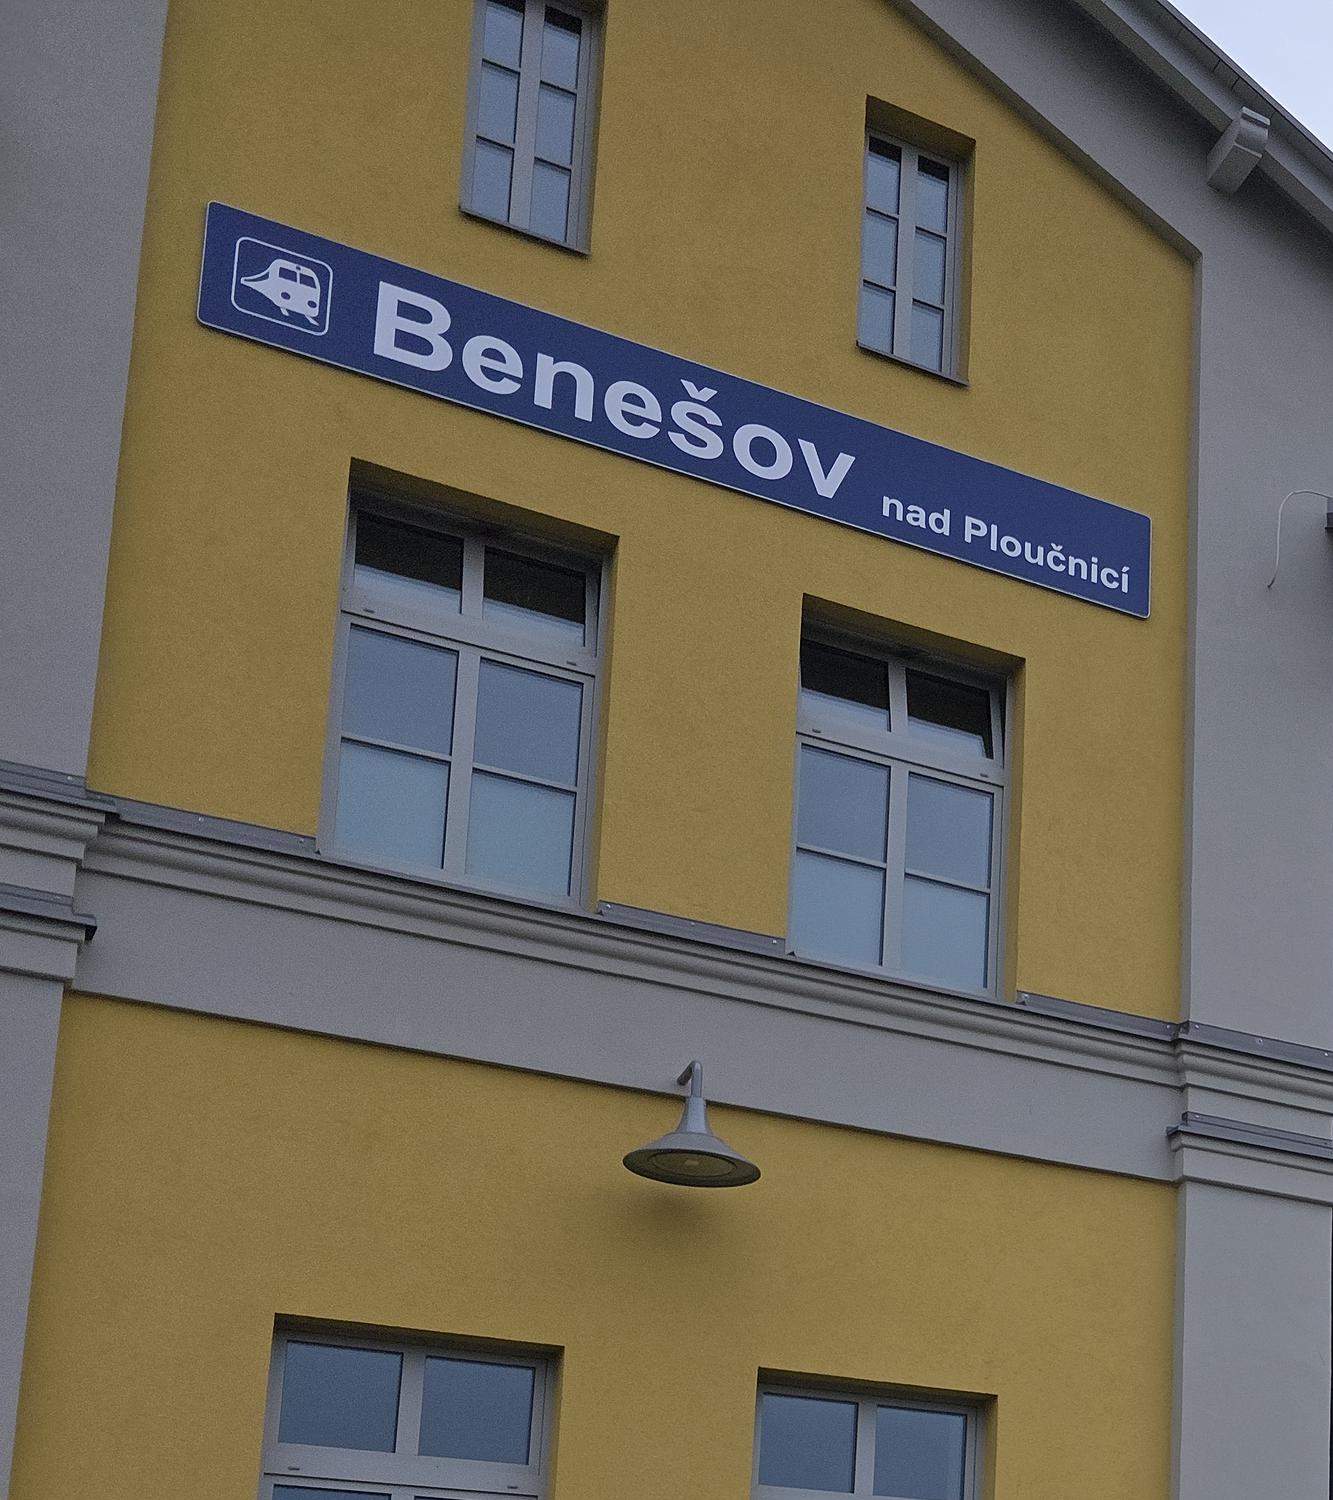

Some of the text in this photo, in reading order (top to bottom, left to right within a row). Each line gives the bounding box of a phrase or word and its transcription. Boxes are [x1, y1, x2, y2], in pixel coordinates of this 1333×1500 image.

[373, 281, 1130, 594] Benešov nad Ploučnicí
